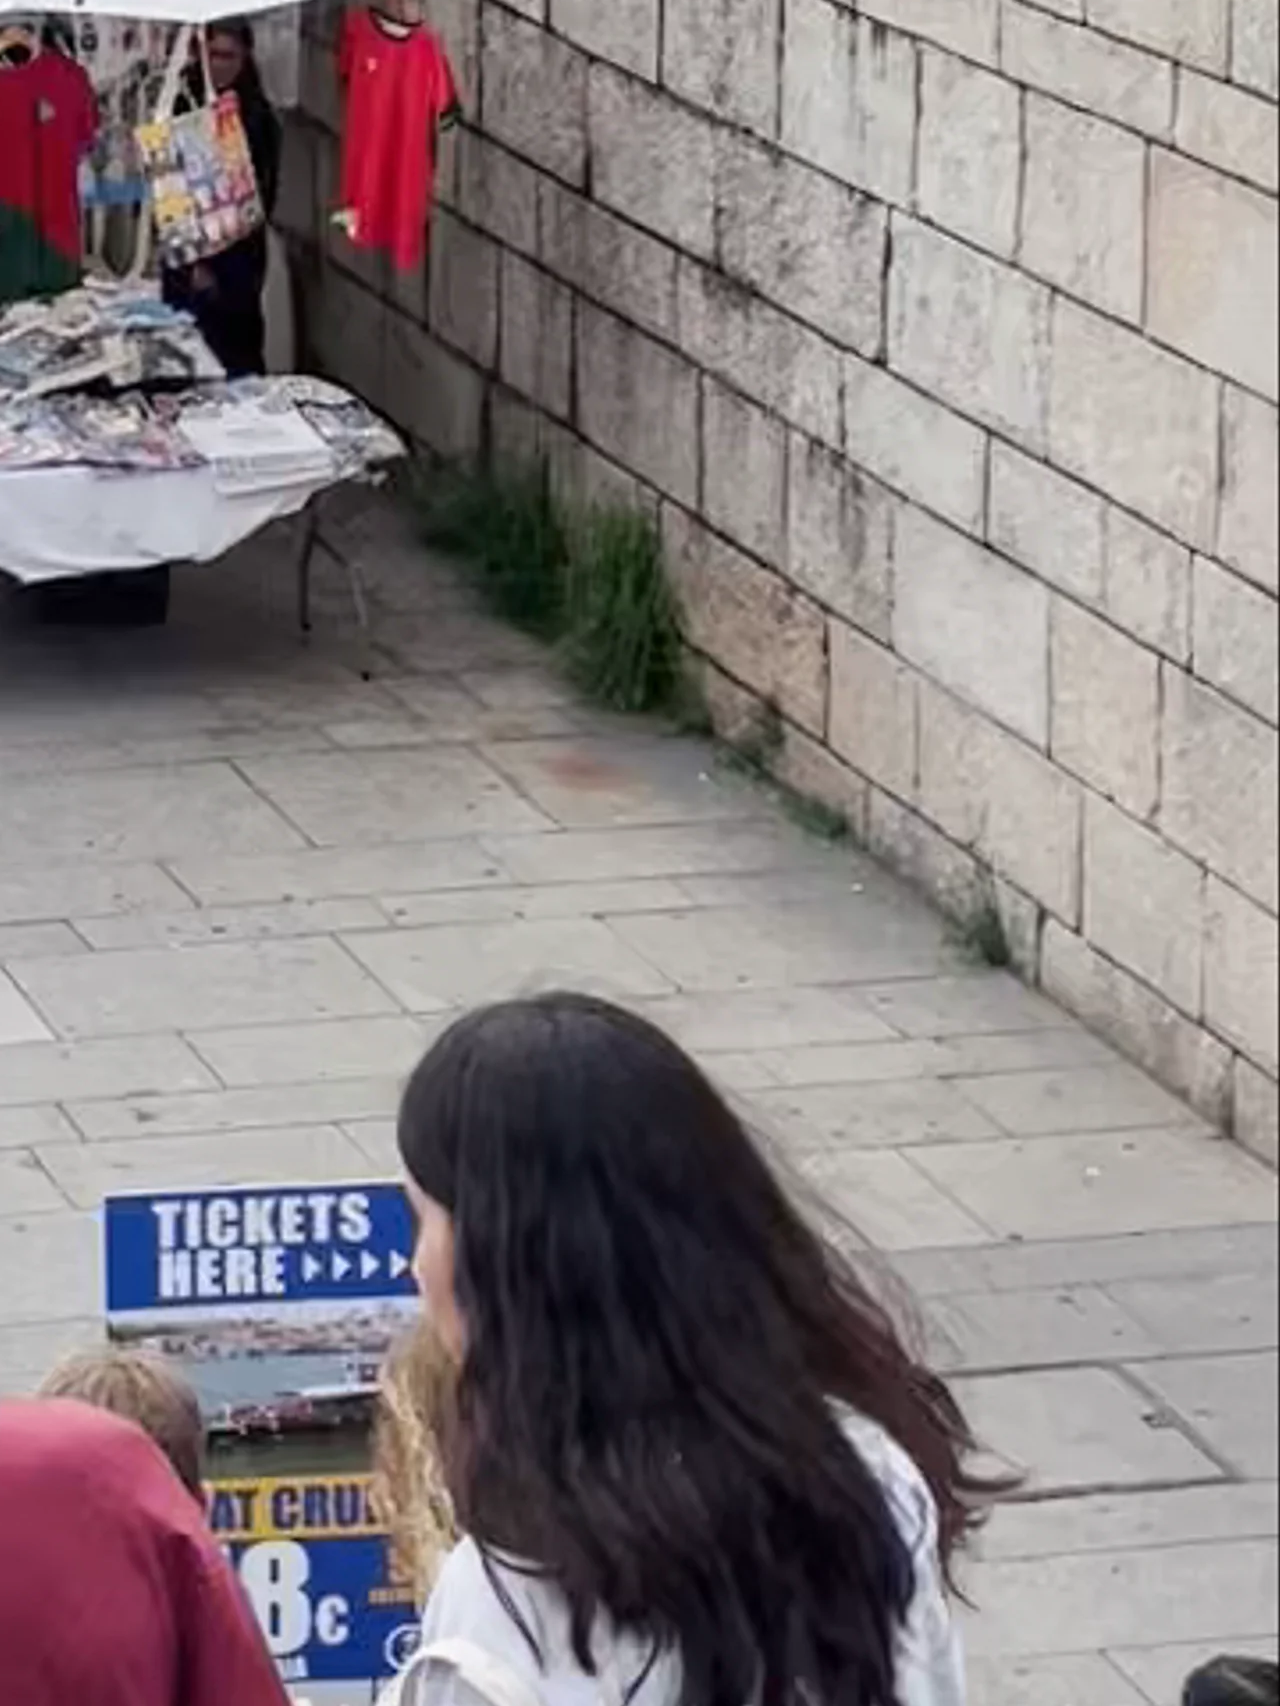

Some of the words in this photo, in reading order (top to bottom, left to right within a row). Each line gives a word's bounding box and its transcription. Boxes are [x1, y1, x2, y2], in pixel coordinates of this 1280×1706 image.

[151, 1192, 372, 1248] TICKETS
[157, 1246, 287, 1298] HERE
[210, 1486, 258, 1532] AT
[222, 1541, 349, 1657] 8€
